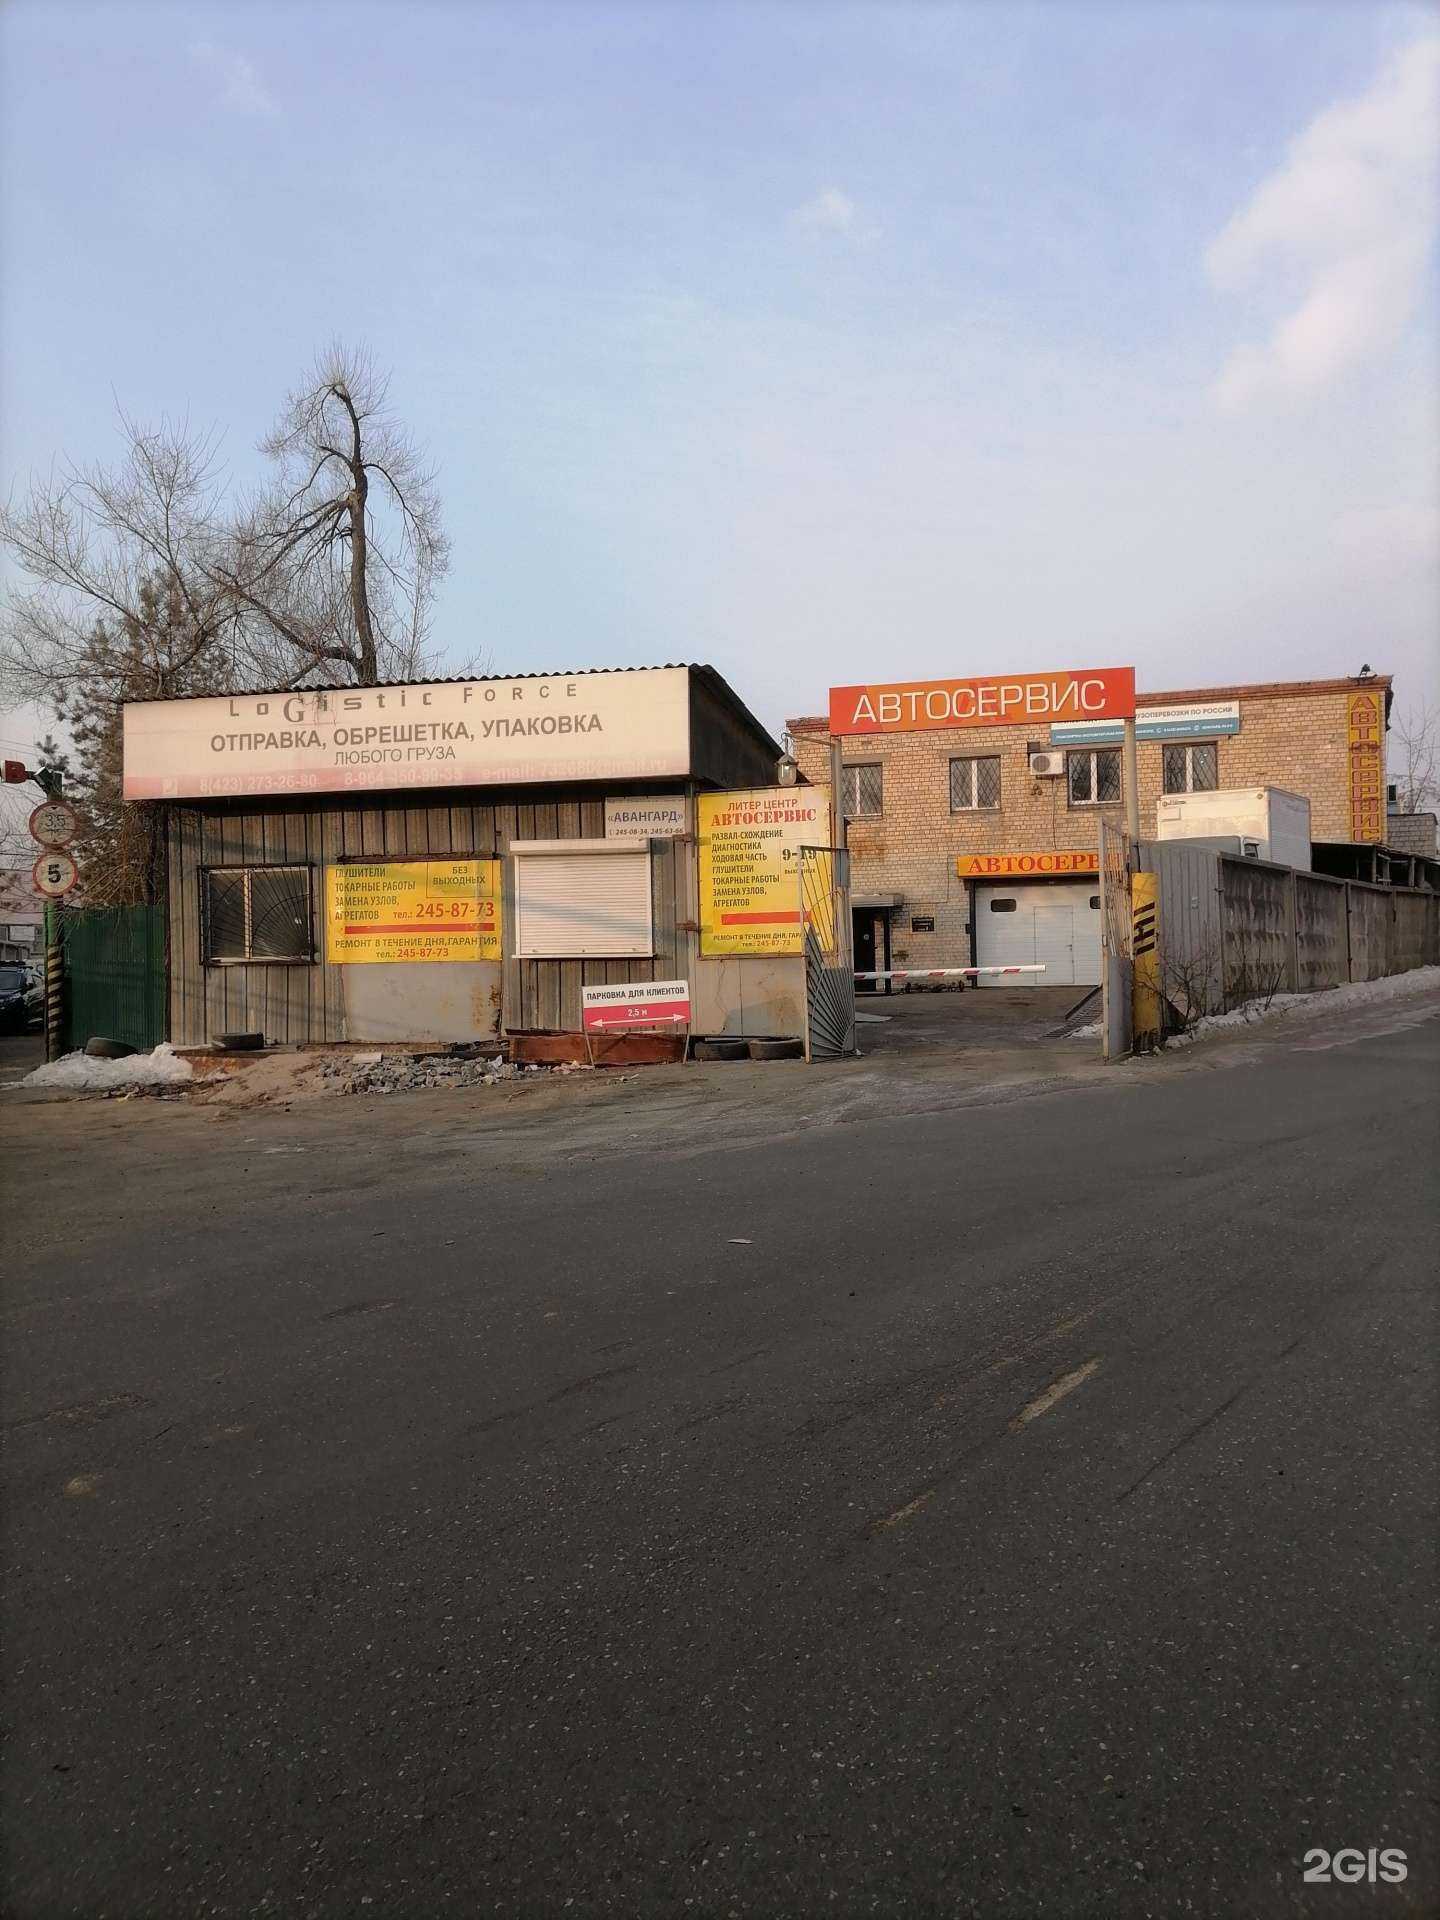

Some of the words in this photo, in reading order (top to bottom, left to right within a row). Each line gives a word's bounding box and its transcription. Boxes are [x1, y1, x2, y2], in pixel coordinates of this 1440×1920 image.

[851, 680, 1107, 725] АВТОСЕРВИС
[1202, 706, 1233, 714] РОССИИ
[210, 731, 327, 752] ОТПРАВКА,
[333, 722, 475, 747] ОБРЕШЕТКА,
[481, 713, 603, 738] УПАКОВКА
[334, 749, 403, 766] ЛЮБОГО
[407, 745, 457, 761] ГРУЗА
[1351, 696, 1380, 842] АВТОСЕРВИС
[728, 801, 761, 811] ЛИТЕР
[763, 798, 798, 809] ЦЕНТР
[711, 808, 817, 827] АВТОСЕРВИС
[711, 829, 784, 841] РАЗВАЛ-СХОЖДЕНИЕ
[711, 841, 762, 853] ДИАГНОСТИКА
[711, 853, 744, 863] ХОДОВАЯ
[745, 852, 768, 862] ЧАСТЬ
[968, 854, 1100, 873] АВТОСЕРВ
[48, 864, 62, 883] 5
[335, 867, 386, 878] ГЛУШИТЕЛИ
[452, 866, 468, 874] БЕЗ
[712, 864, 754, 874] ГЛУШИТЕЛИ
[433, 876, 486, 886] ВЫХОДНЫХ
[712, 876, 750, 885] ТОКАРНЫЕ
[751, 874, 780, 884] РАБОТЫ
[335, 881, 381, 892] ТОКАРНЫЕ
[382, 880, 416, 892] РАБОТЫ
[712, 888, 741, 897] ЗАМЕНА
[742, 886, 767, 896] УЗЛОВ,
[335, 897, 369, 907] ЗАМЕНА
[370, 896, 400, 906] УЗЛОВ,
[335, 910, 379, 921] АГРЕГАТОВ
[416, 903, 495, 918] 245-87-73
[335, 940, 371, 949] РЕМОНТ
[383, 938, 423, 947] ТЕЧЕНИЕ
[397, 949, 449, 958] 245-87-73
[587, 991, 626, 1000] ПАРКОВКА
[628, 989, 644, 998] ДЛЯ
[646, 986, 685, 996] КЛИЕНТОВ
[627, 1008, 640, 1017] 2,5
